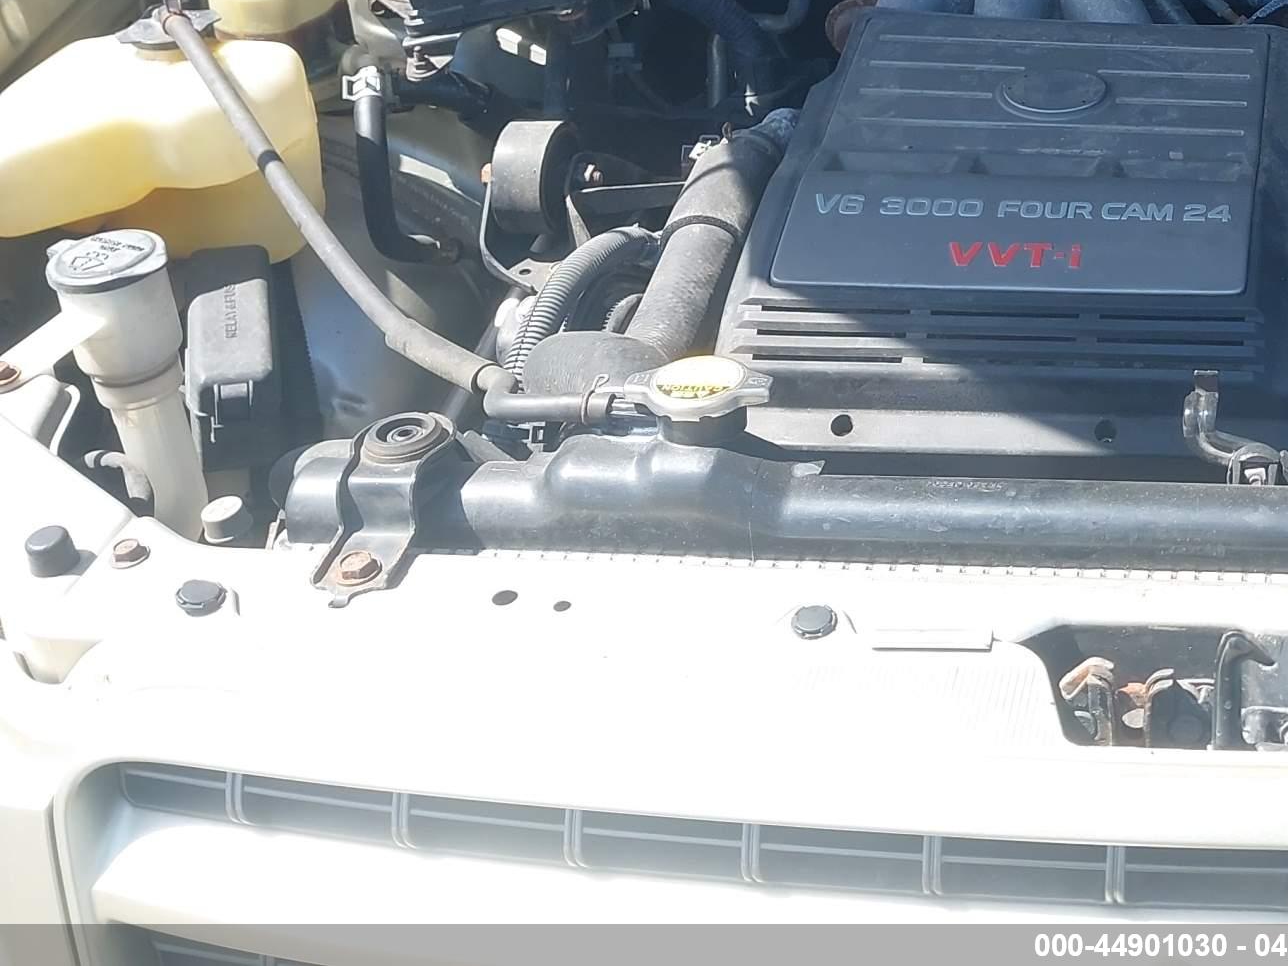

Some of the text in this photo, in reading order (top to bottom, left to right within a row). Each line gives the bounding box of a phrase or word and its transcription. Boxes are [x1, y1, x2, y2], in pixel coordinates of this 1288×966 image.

[815, 193, 1232, 223] V6 3000 FOUR CAM 24
[948, 241, 1083, 268] VVT-i
[661, 384, 725, 393] CAUTION
